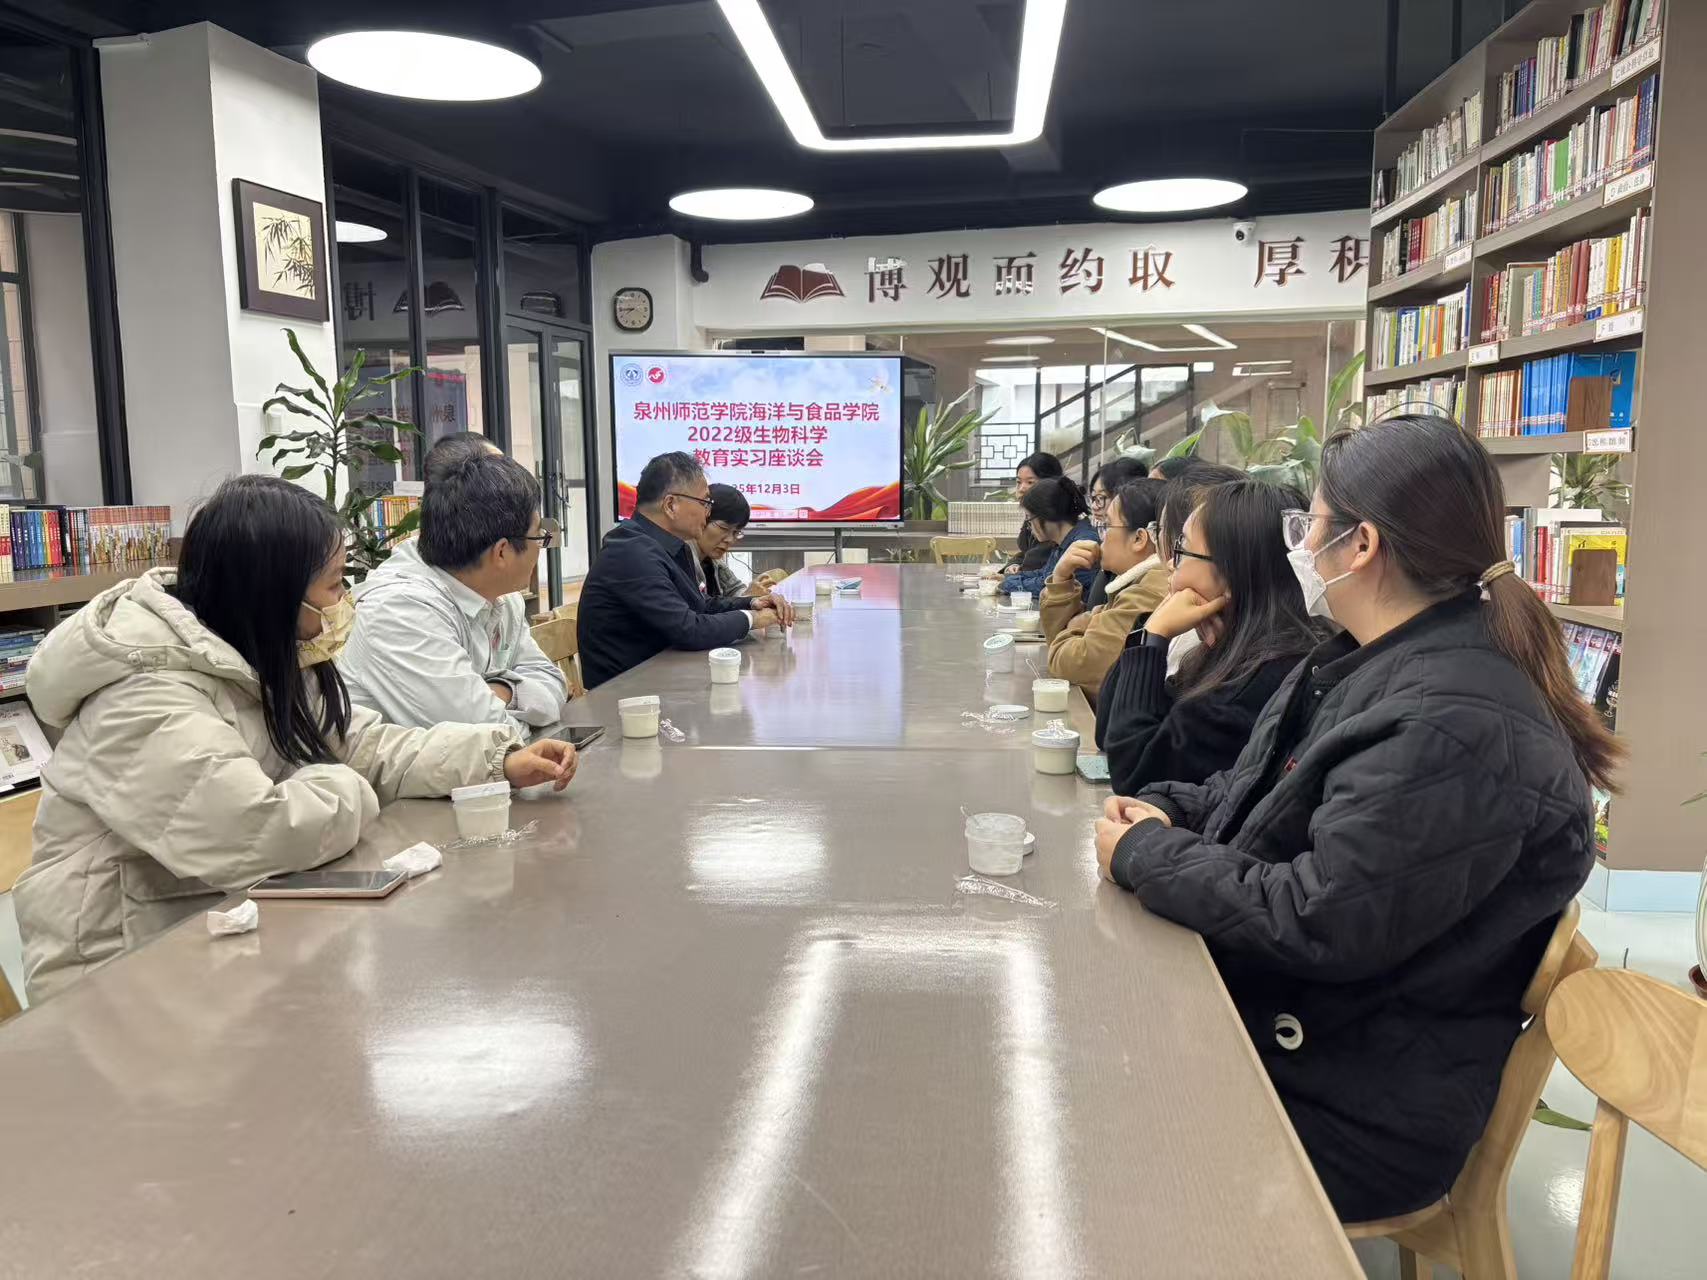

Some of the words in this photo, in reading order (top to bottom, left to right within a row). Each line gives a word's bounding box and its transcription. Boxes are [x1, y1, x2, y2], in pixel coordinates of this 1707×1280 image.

[864, 246, 1176, 304] 博观而约取
[633, 401, 880, 421] 泉州师范学院海洋与食品学院
[687, 425, 828, 444] 2022级生物科学
[693, 448, 824, 468] 教育实习座谈会
